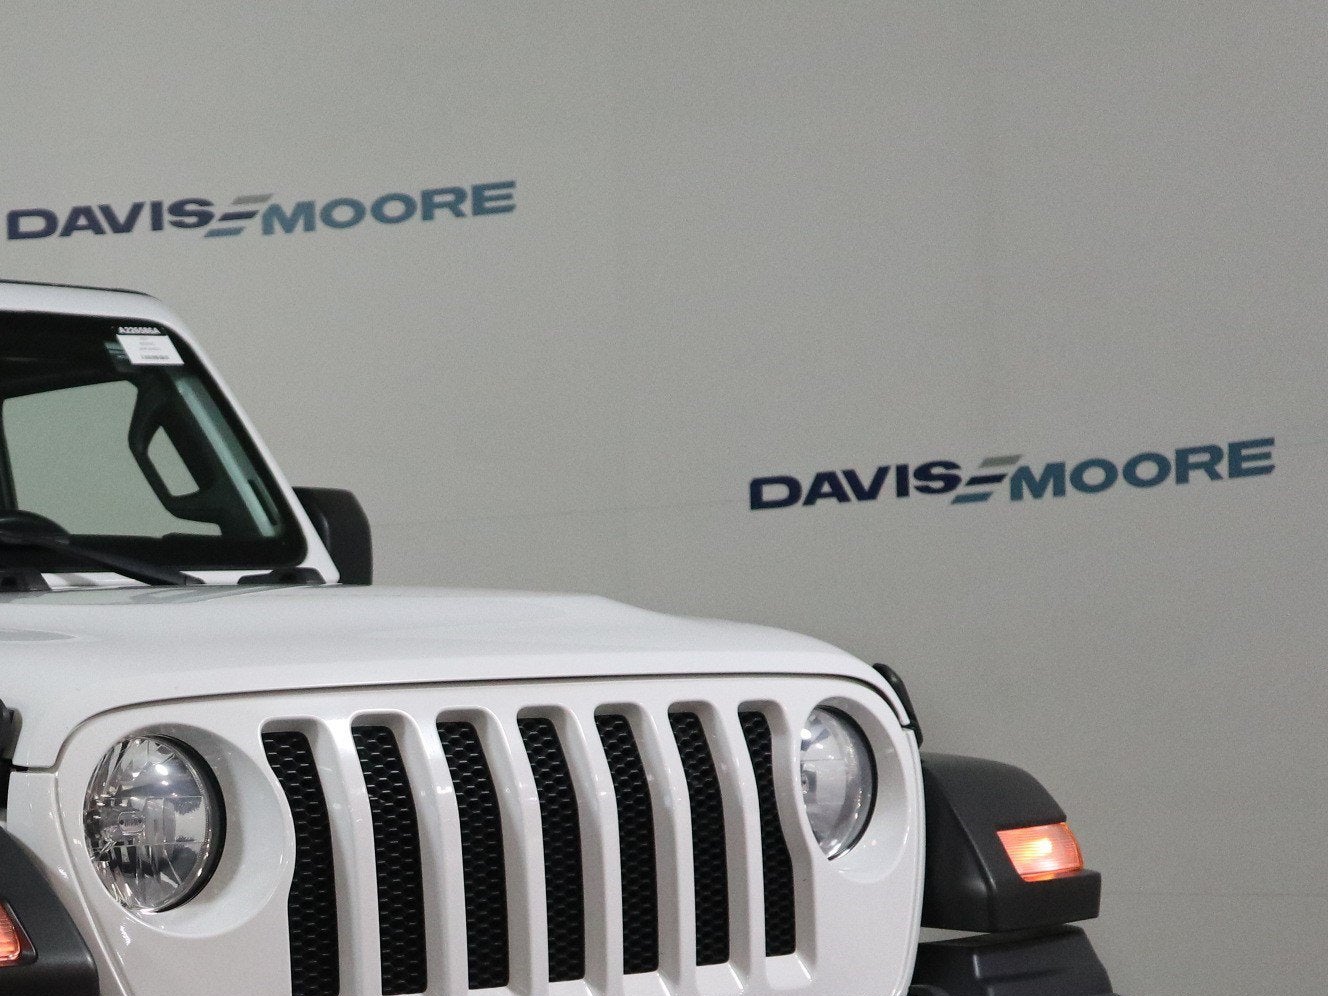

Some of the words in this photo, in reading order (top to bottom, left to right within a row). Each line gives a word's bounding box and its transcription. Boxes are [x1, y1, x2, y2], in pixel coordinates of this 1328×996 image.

[6, 198, 215, 241] DAVIS
[261, 180, 516, 236] MOORE
[750, 460, 962, 511] DAVIS
[1009, 438, 1275, 502] MOORE
